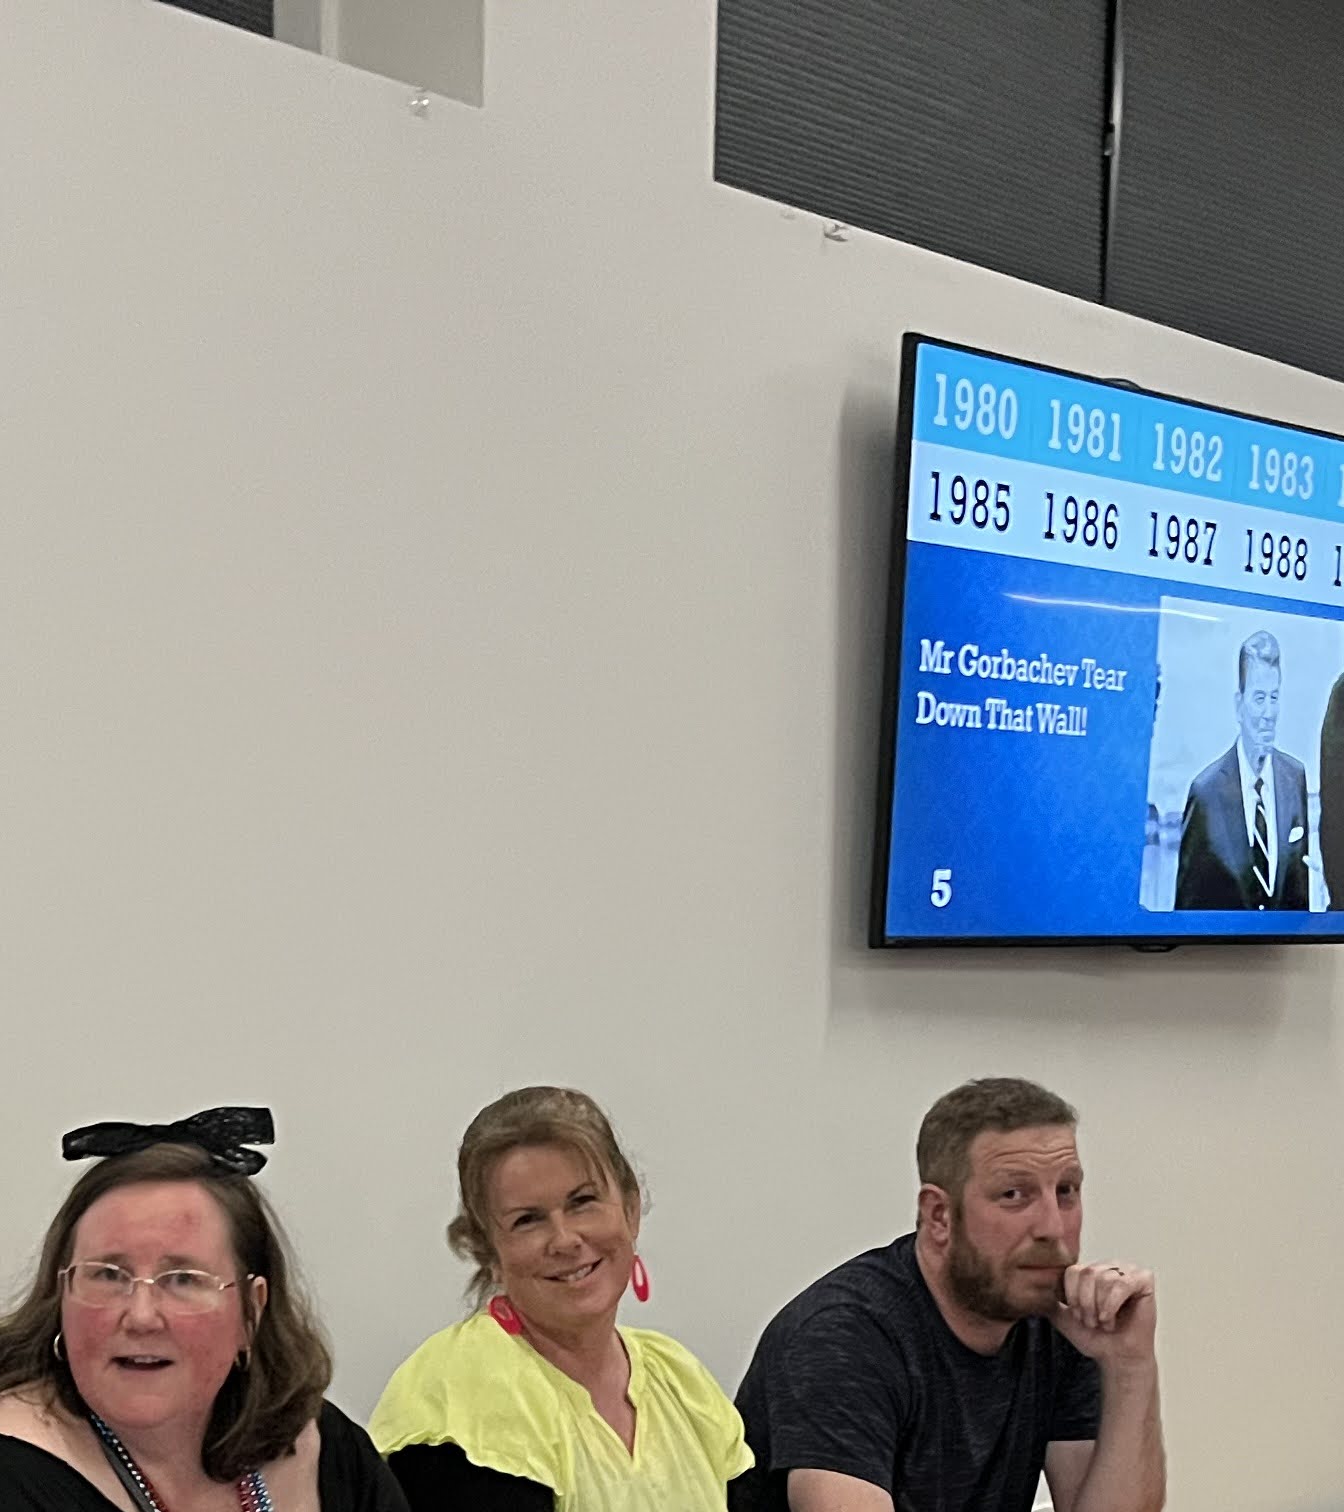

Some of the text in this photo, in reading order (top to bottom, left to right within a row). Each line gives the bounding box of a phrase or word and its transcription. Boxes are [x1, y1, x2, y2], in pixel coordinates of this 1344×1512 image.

[933, 373, 1018, 440] 1980
[1048, 399, 1121, 462] 1981
[1152, 422, 1224, 482] 1982
[1248, 444, 1315, 500] 1983
[929, 471, 1011, 532] 1985
[1043, 492, 1119, 550] 1986
[1148, 511, 1217, 566] 1987
[1244, 529, 1308, 581] 1988
[919, 638, 1128, 692] Mr Gorbachev Tear
[915, 691, 1089, 737] Down That Wall!
[930, 868, 953, 908] 5
